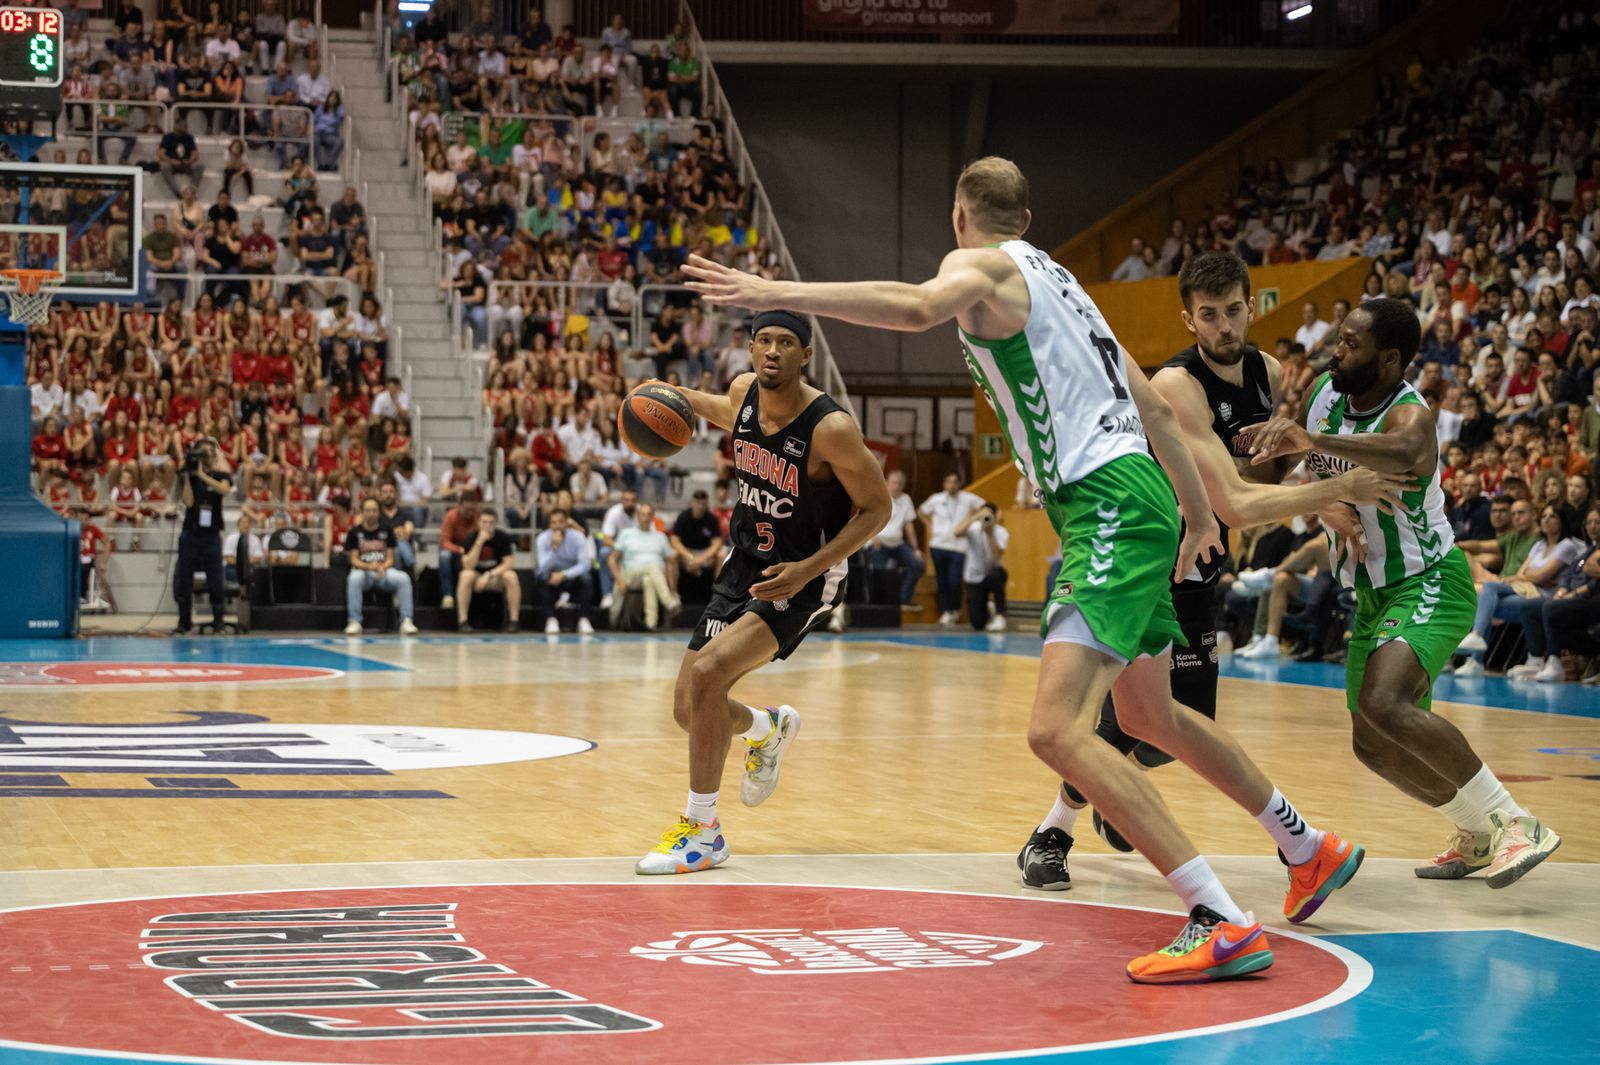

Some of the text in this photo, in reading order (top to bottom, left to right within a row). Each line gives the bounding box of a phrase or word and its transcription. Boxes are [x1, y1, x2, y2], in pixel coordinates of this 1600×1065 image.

[1, 10, 58, 33] 03:12
[861, 11, 914, 26] girona
[939, 11, 992, 26] esport
[30, 34, 54, 71] 8
[733, 439, 799, 498] GIRONA
[755, 522, 776, 552] 5
[1176, 653, 1197, 661] Kave
[1177, 660, 1202, 668] Home
[813, 926, 995, 968] GIRONA
[138, 903, 664, 1040] GIRONA
